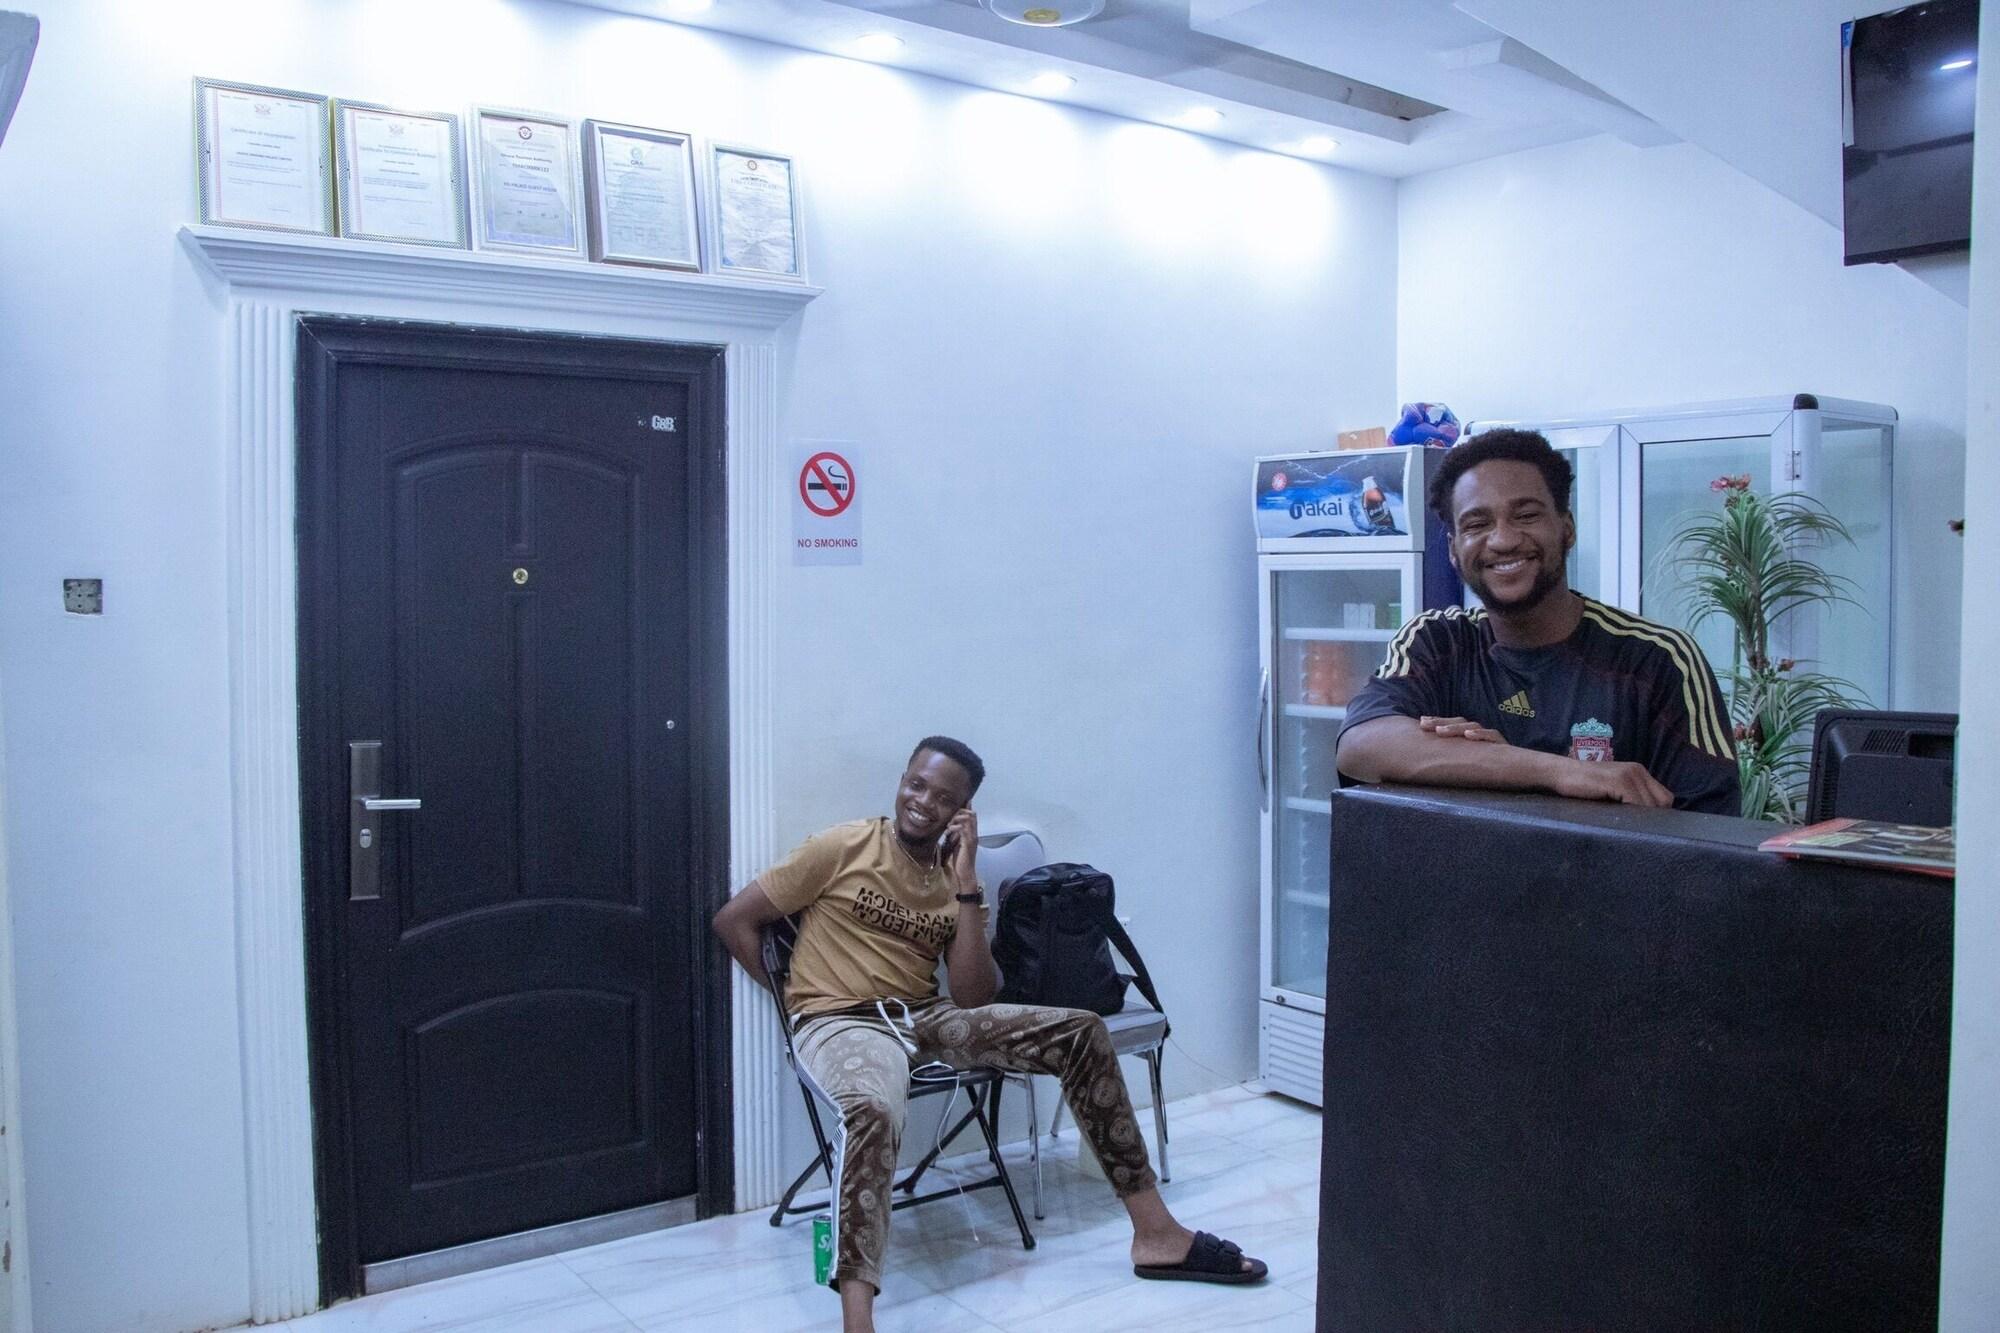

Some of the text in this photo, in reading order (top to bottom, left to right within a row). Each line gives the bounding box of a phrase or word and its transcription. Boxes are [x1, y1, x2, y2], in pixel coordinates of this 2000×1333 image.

[797, 538, 859, 548] NO SMOKING
[1498, 702, 1536, 719] adidas
